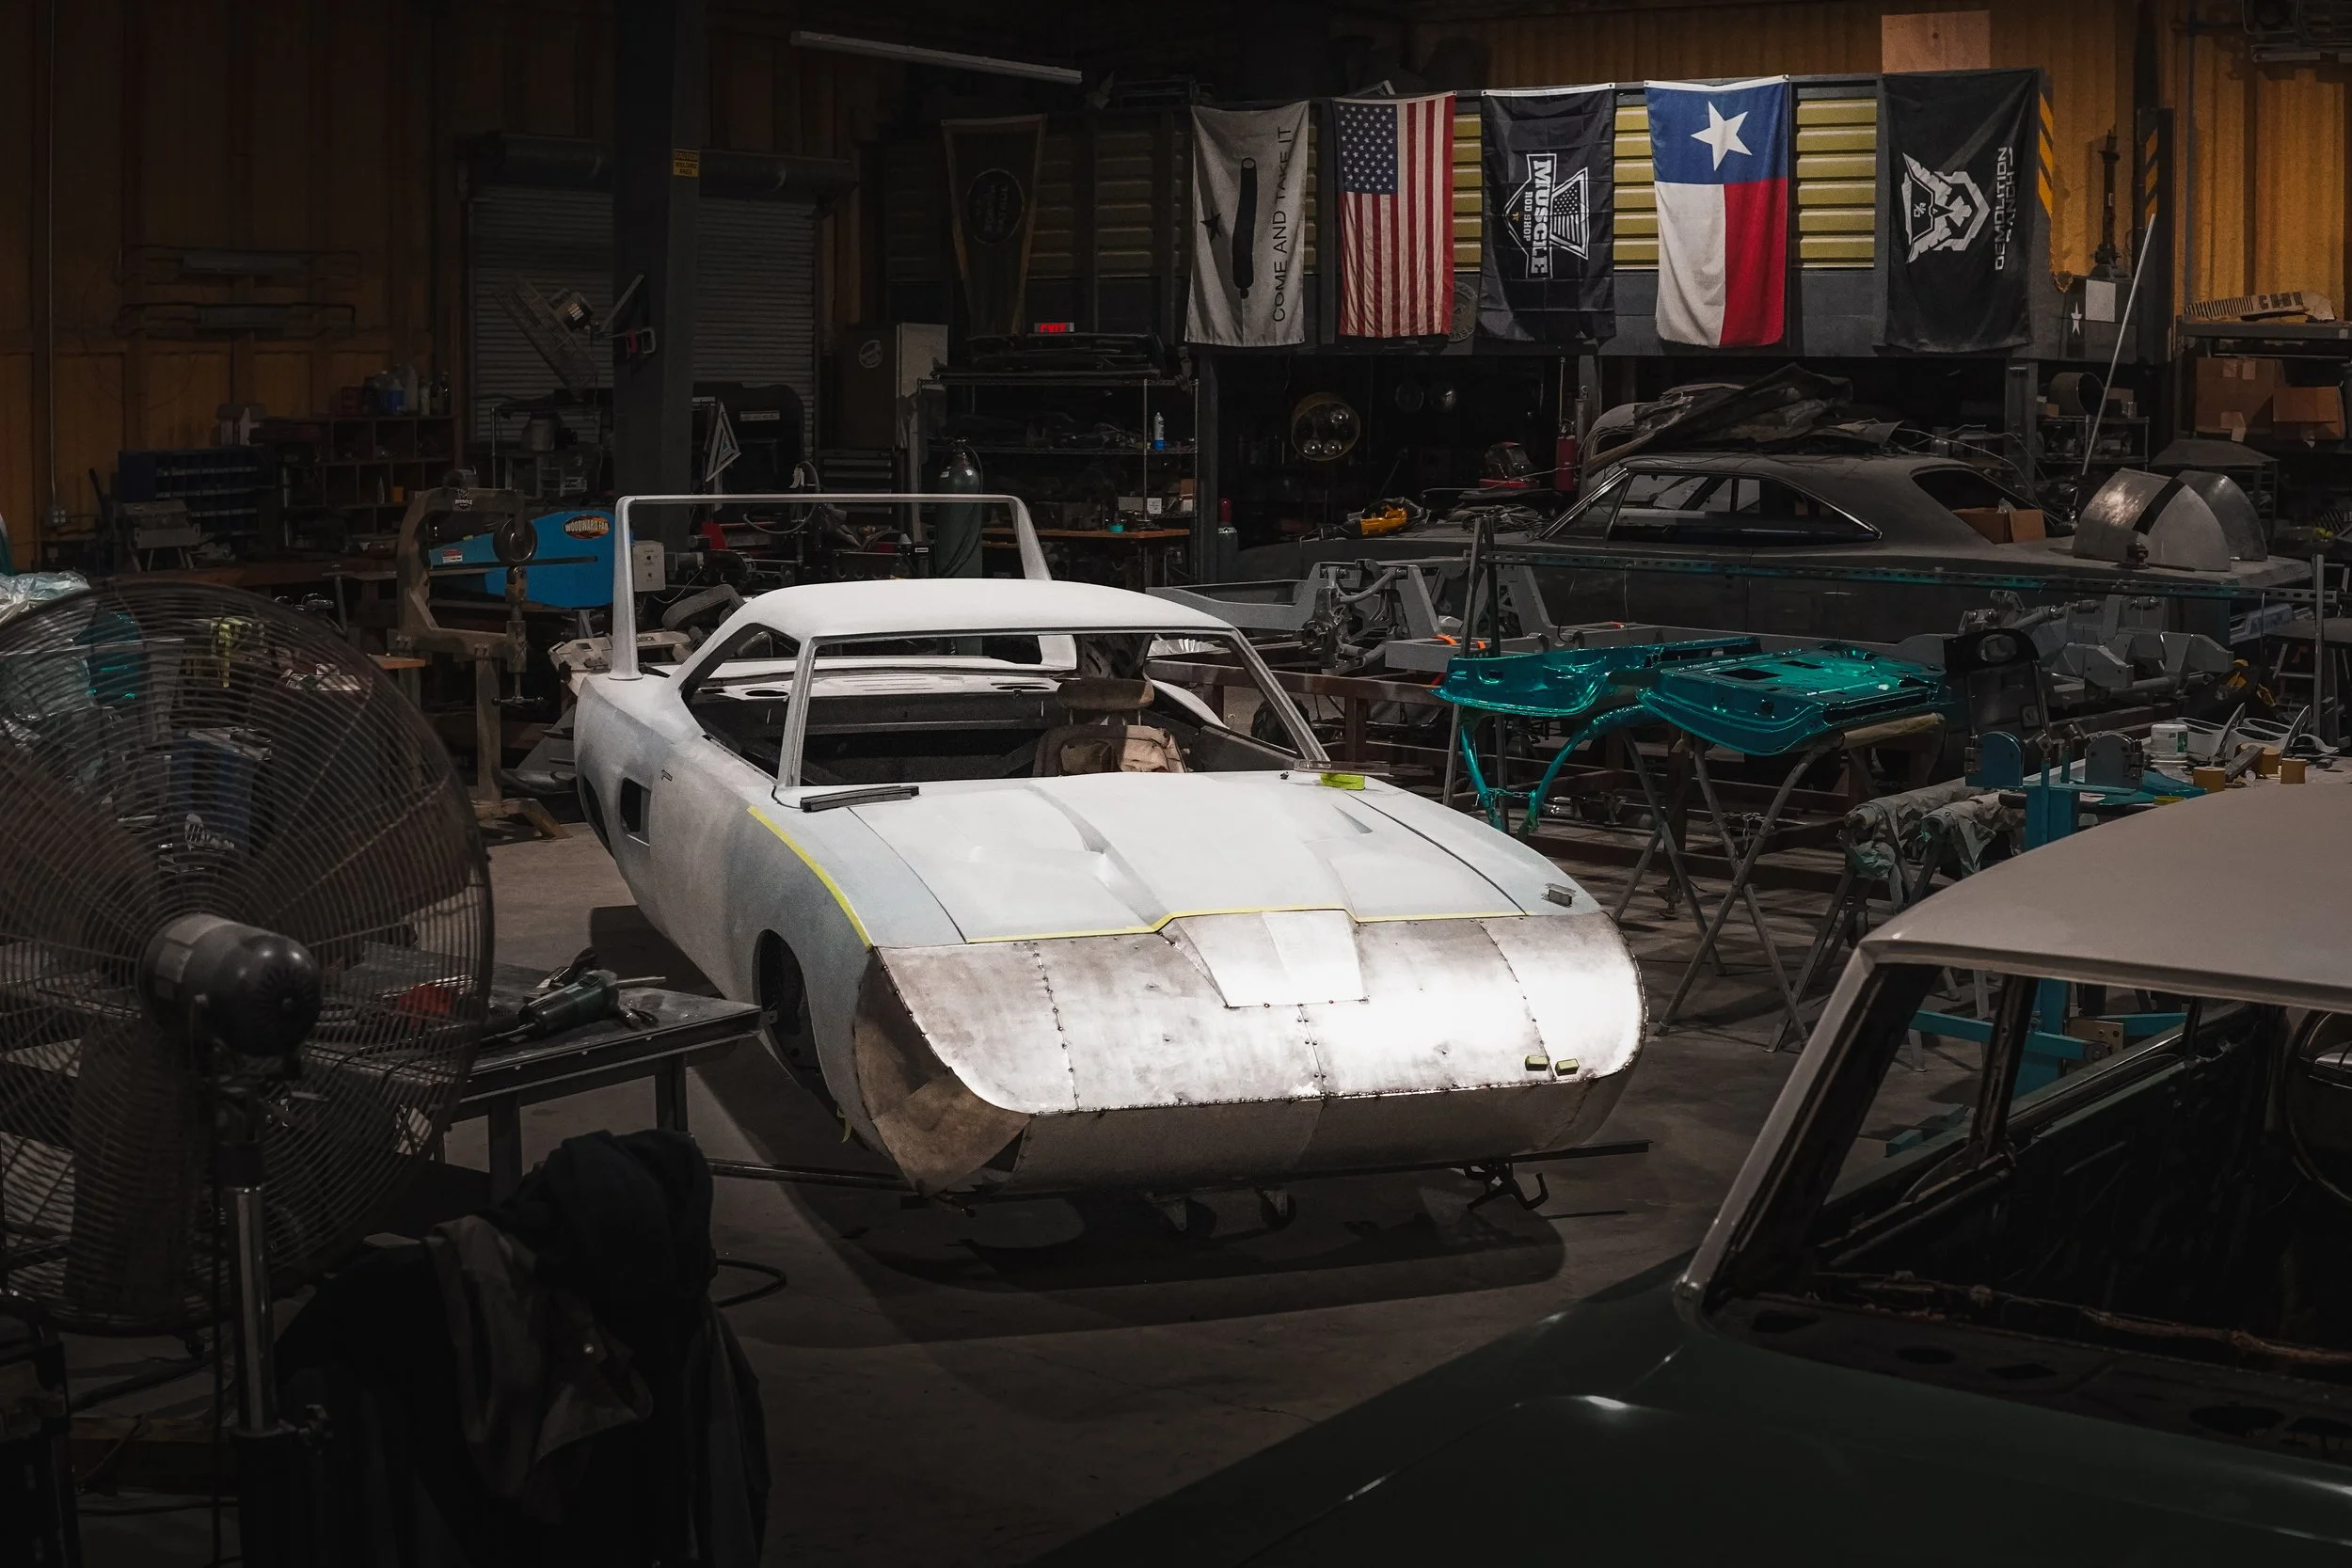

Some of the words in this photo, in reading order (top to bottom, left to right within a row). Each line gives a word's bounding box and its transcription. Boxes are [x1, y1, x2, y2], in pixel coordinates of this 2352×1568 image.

[1278, 126, 1293, 143] IT
[1277, 151, 1289, 200] TAKE
[1524, 191, 1534, 213] ROD
[1531, 160, 1552, 274] MUSCLE
[1994, 146, 2008, 271] DEMOLITION
[1273, 211, 1288, 254] AND
[1523, 214, 1533, 242] SHOP
[1273, 261, 1288, 322] COME
